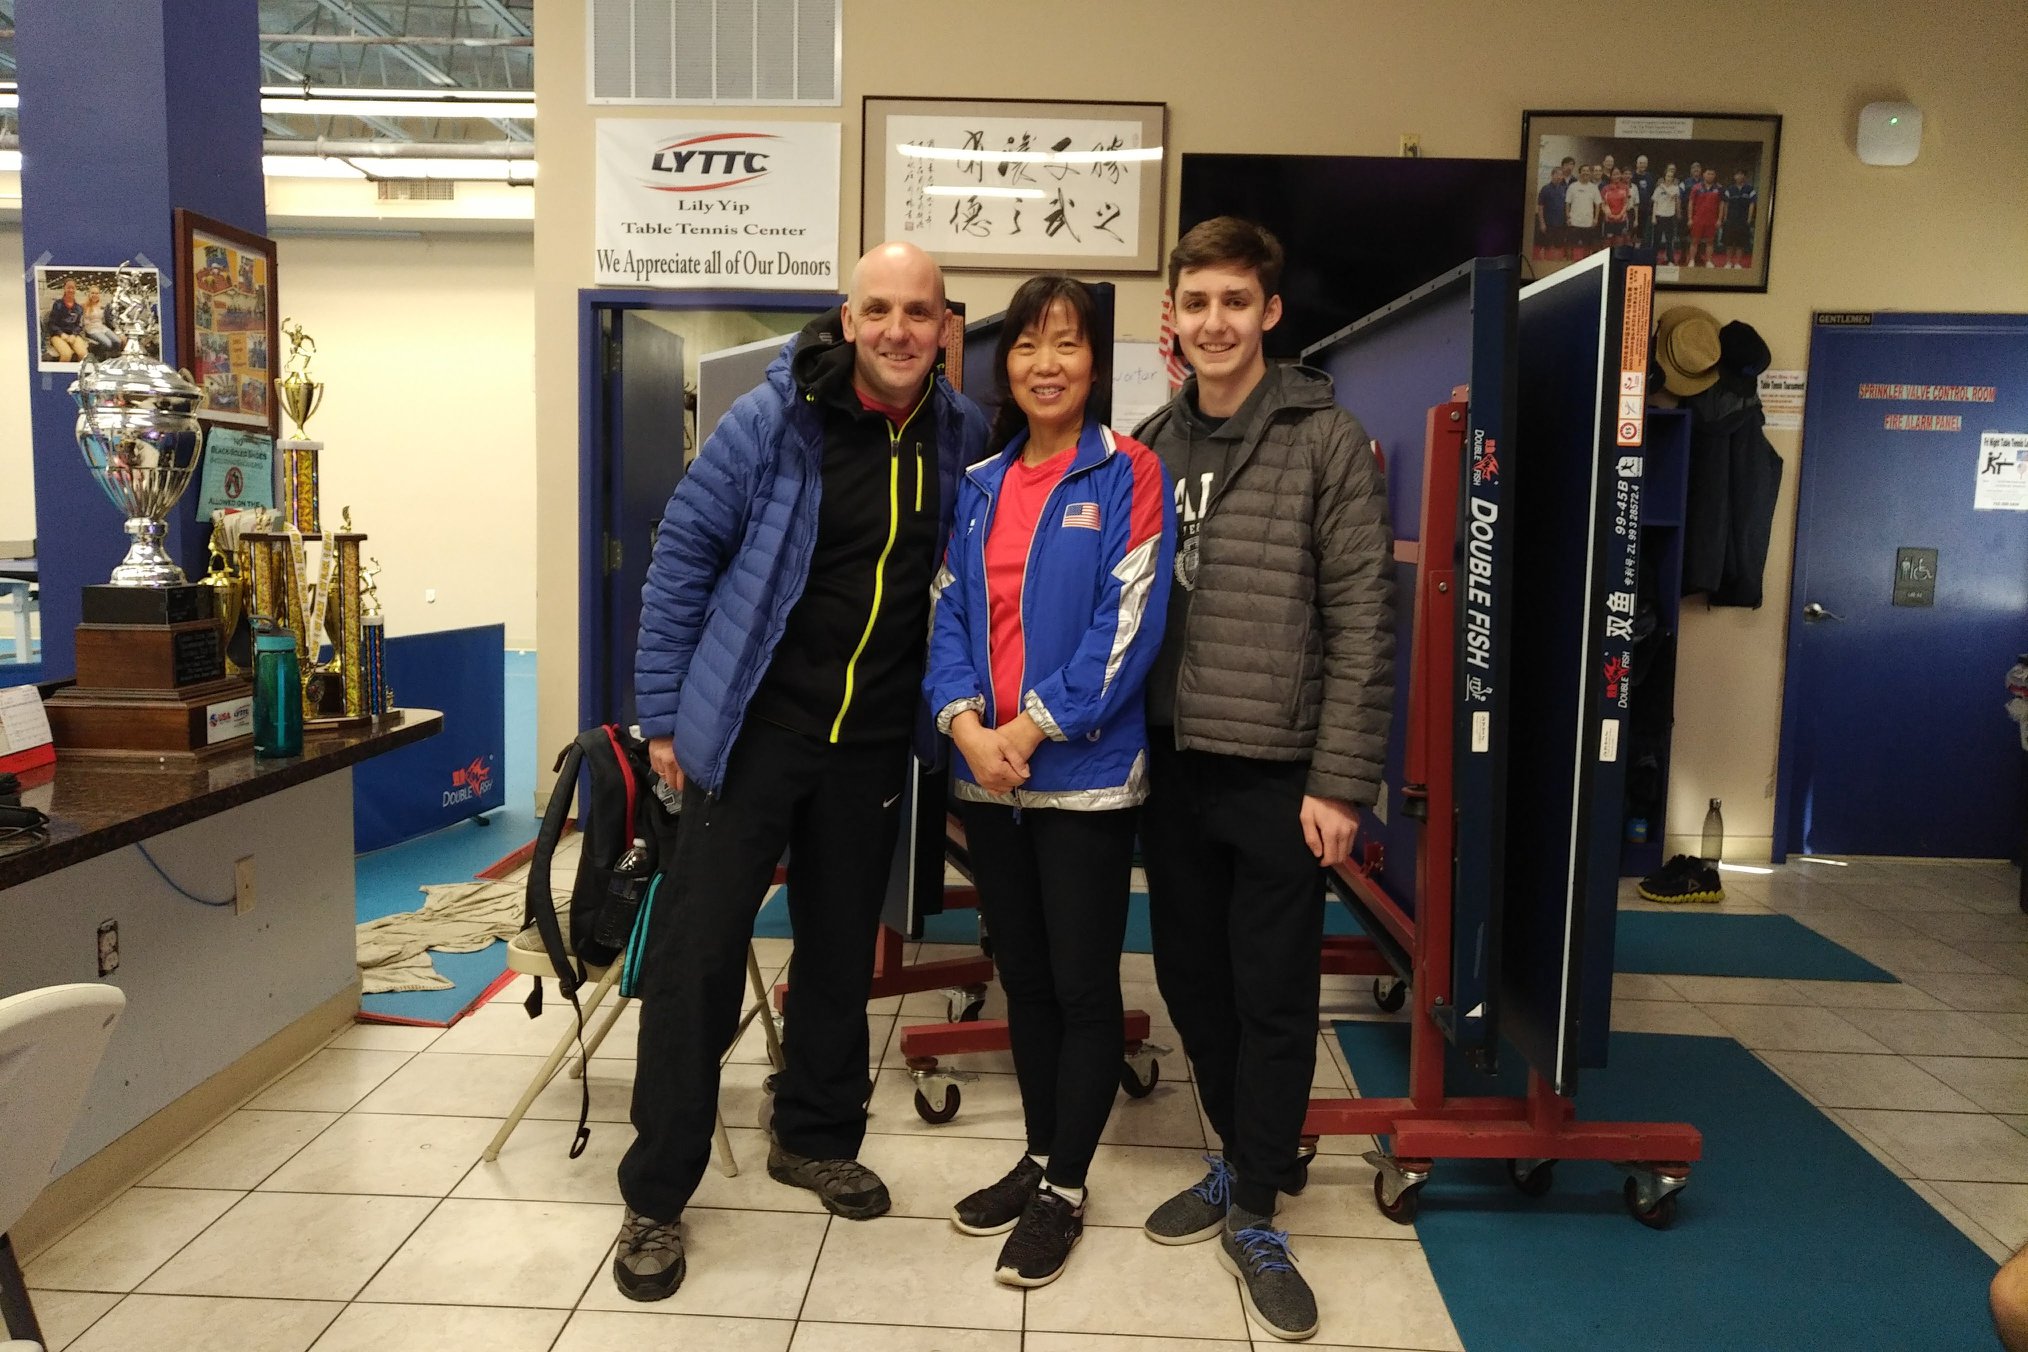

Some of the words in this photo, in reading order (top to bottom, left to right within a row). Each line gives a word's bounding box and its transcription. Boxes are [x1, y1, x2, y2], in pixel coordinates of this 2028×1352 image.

[651, 150, 771, 175] LYTTC
[678, 199, 714, 214] Lily
[717, 199, 750, 214] Yip
[621, 222, 673, 236] Table
[676, 223, 738, 236] Tennis
[743, 223, 807, 237] Center
[597, 249, 620, 273] We
[623, 249, 701, 282] Appreciate
[704, 250, 721, 275] all
[725, 250, 742, 275] of
[743, 250, 774, 275] Our
[777, 251, 831, 277] Donors
[1819, 314, 1870, 324] GENTLEMEN
[1860, 383, 1904, 399] SPRINKLER
[1907, 385, 1930, 400] VALVE
[1933, 385, 1969, 400] CONTROL
[1972, 386, 1996, 402] ROOM
[1885, 414, 1903, 430] FIRE
[1905, 415, 1933, 430] ALARM
[1935, 415, 1960, 431] PANEL
[1473, 429, 1484, 460] DOUBLE
[1473, 469, 1482, 486] FISH
[1615, 480, 1629, 536] 99-45B
[1629, 484, 1640, 521] 28572.4
[1628, 528, 1637, 541] 99
[1467, 496, 1498, 607] DOUBLE
[1626, 542, 1636, 555] ZL
[1606, 591, 1636, 642] 双鱼
[1466, 608, 1490, 670] FISH
[1621, 651, 1631, 669] FISH
[1617, 676, 1629, 708] DOUBLE
[443, 786, 473, 808] DOUBLE
